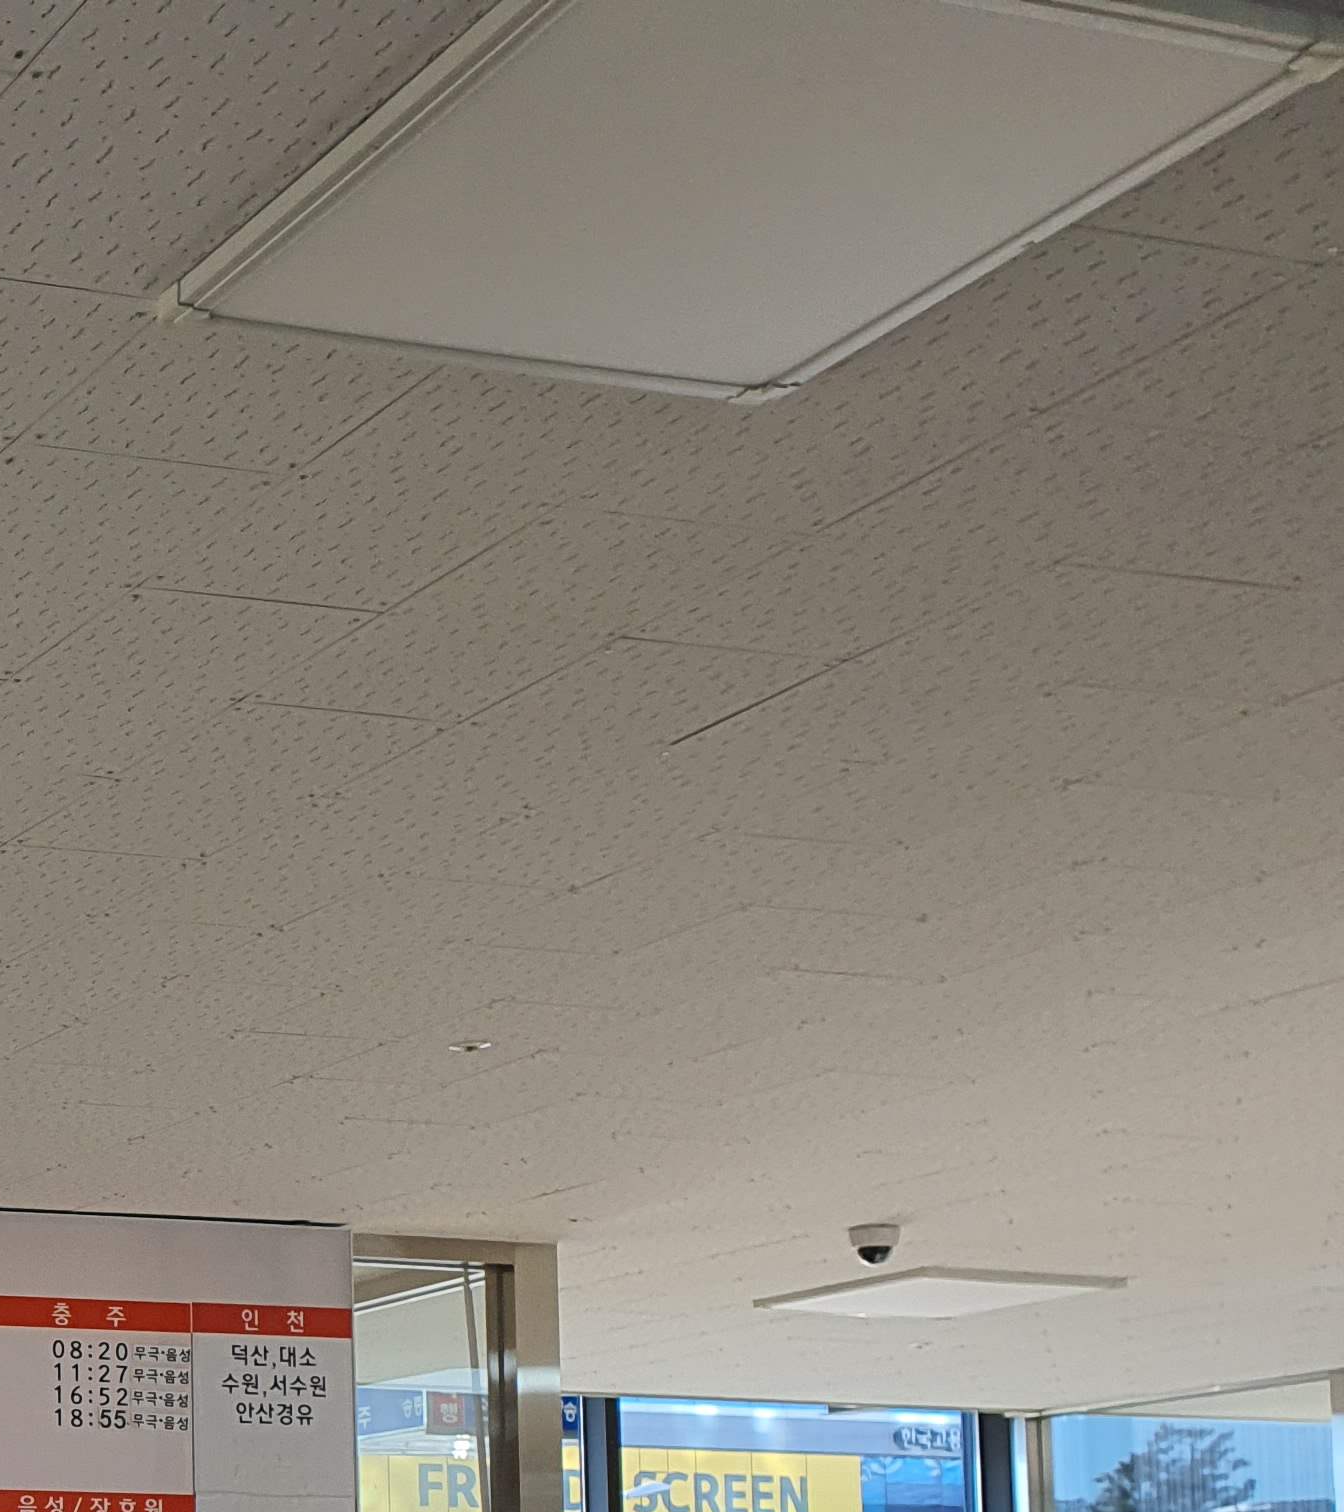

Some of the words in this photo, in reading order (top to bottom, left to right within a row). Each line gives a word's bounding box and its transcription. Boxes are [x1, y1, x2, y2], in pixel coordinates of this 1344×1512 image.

[53, 1340, 127, 1361] 08:20
[55, 1363, 127, 1383] 11:27
[55, 1386, 128, 1406] 16:52
[55, 1409, 126, 1429] 18:55
[236, 1403, 313, 1425] 안산경유
